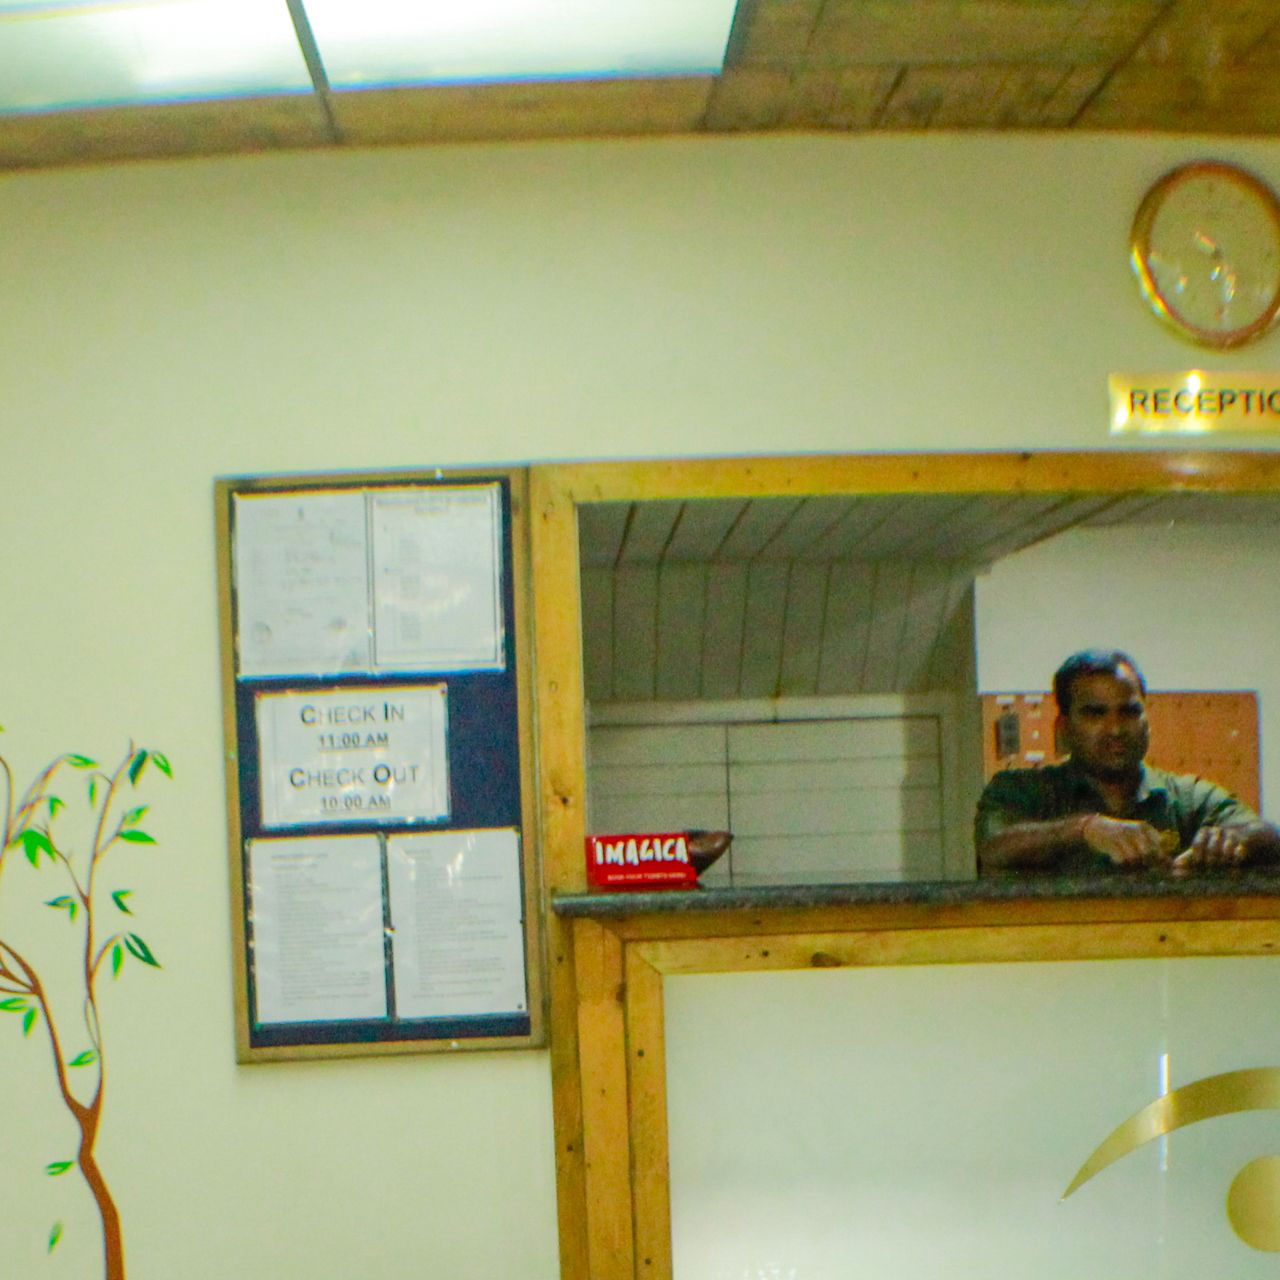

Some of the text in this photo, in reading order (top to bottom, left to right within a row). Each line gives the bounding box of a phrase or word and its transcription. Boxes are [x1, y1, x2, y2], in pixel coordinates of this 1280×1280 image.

[301, 701, 405, 724] CHECK IN
[365, 731, 390, 748] AM
[289, 763, 419, 788] CHECK OUT
[367, 793, 392, 810] AM
[595, 837, 689, 866] IMAGICA
